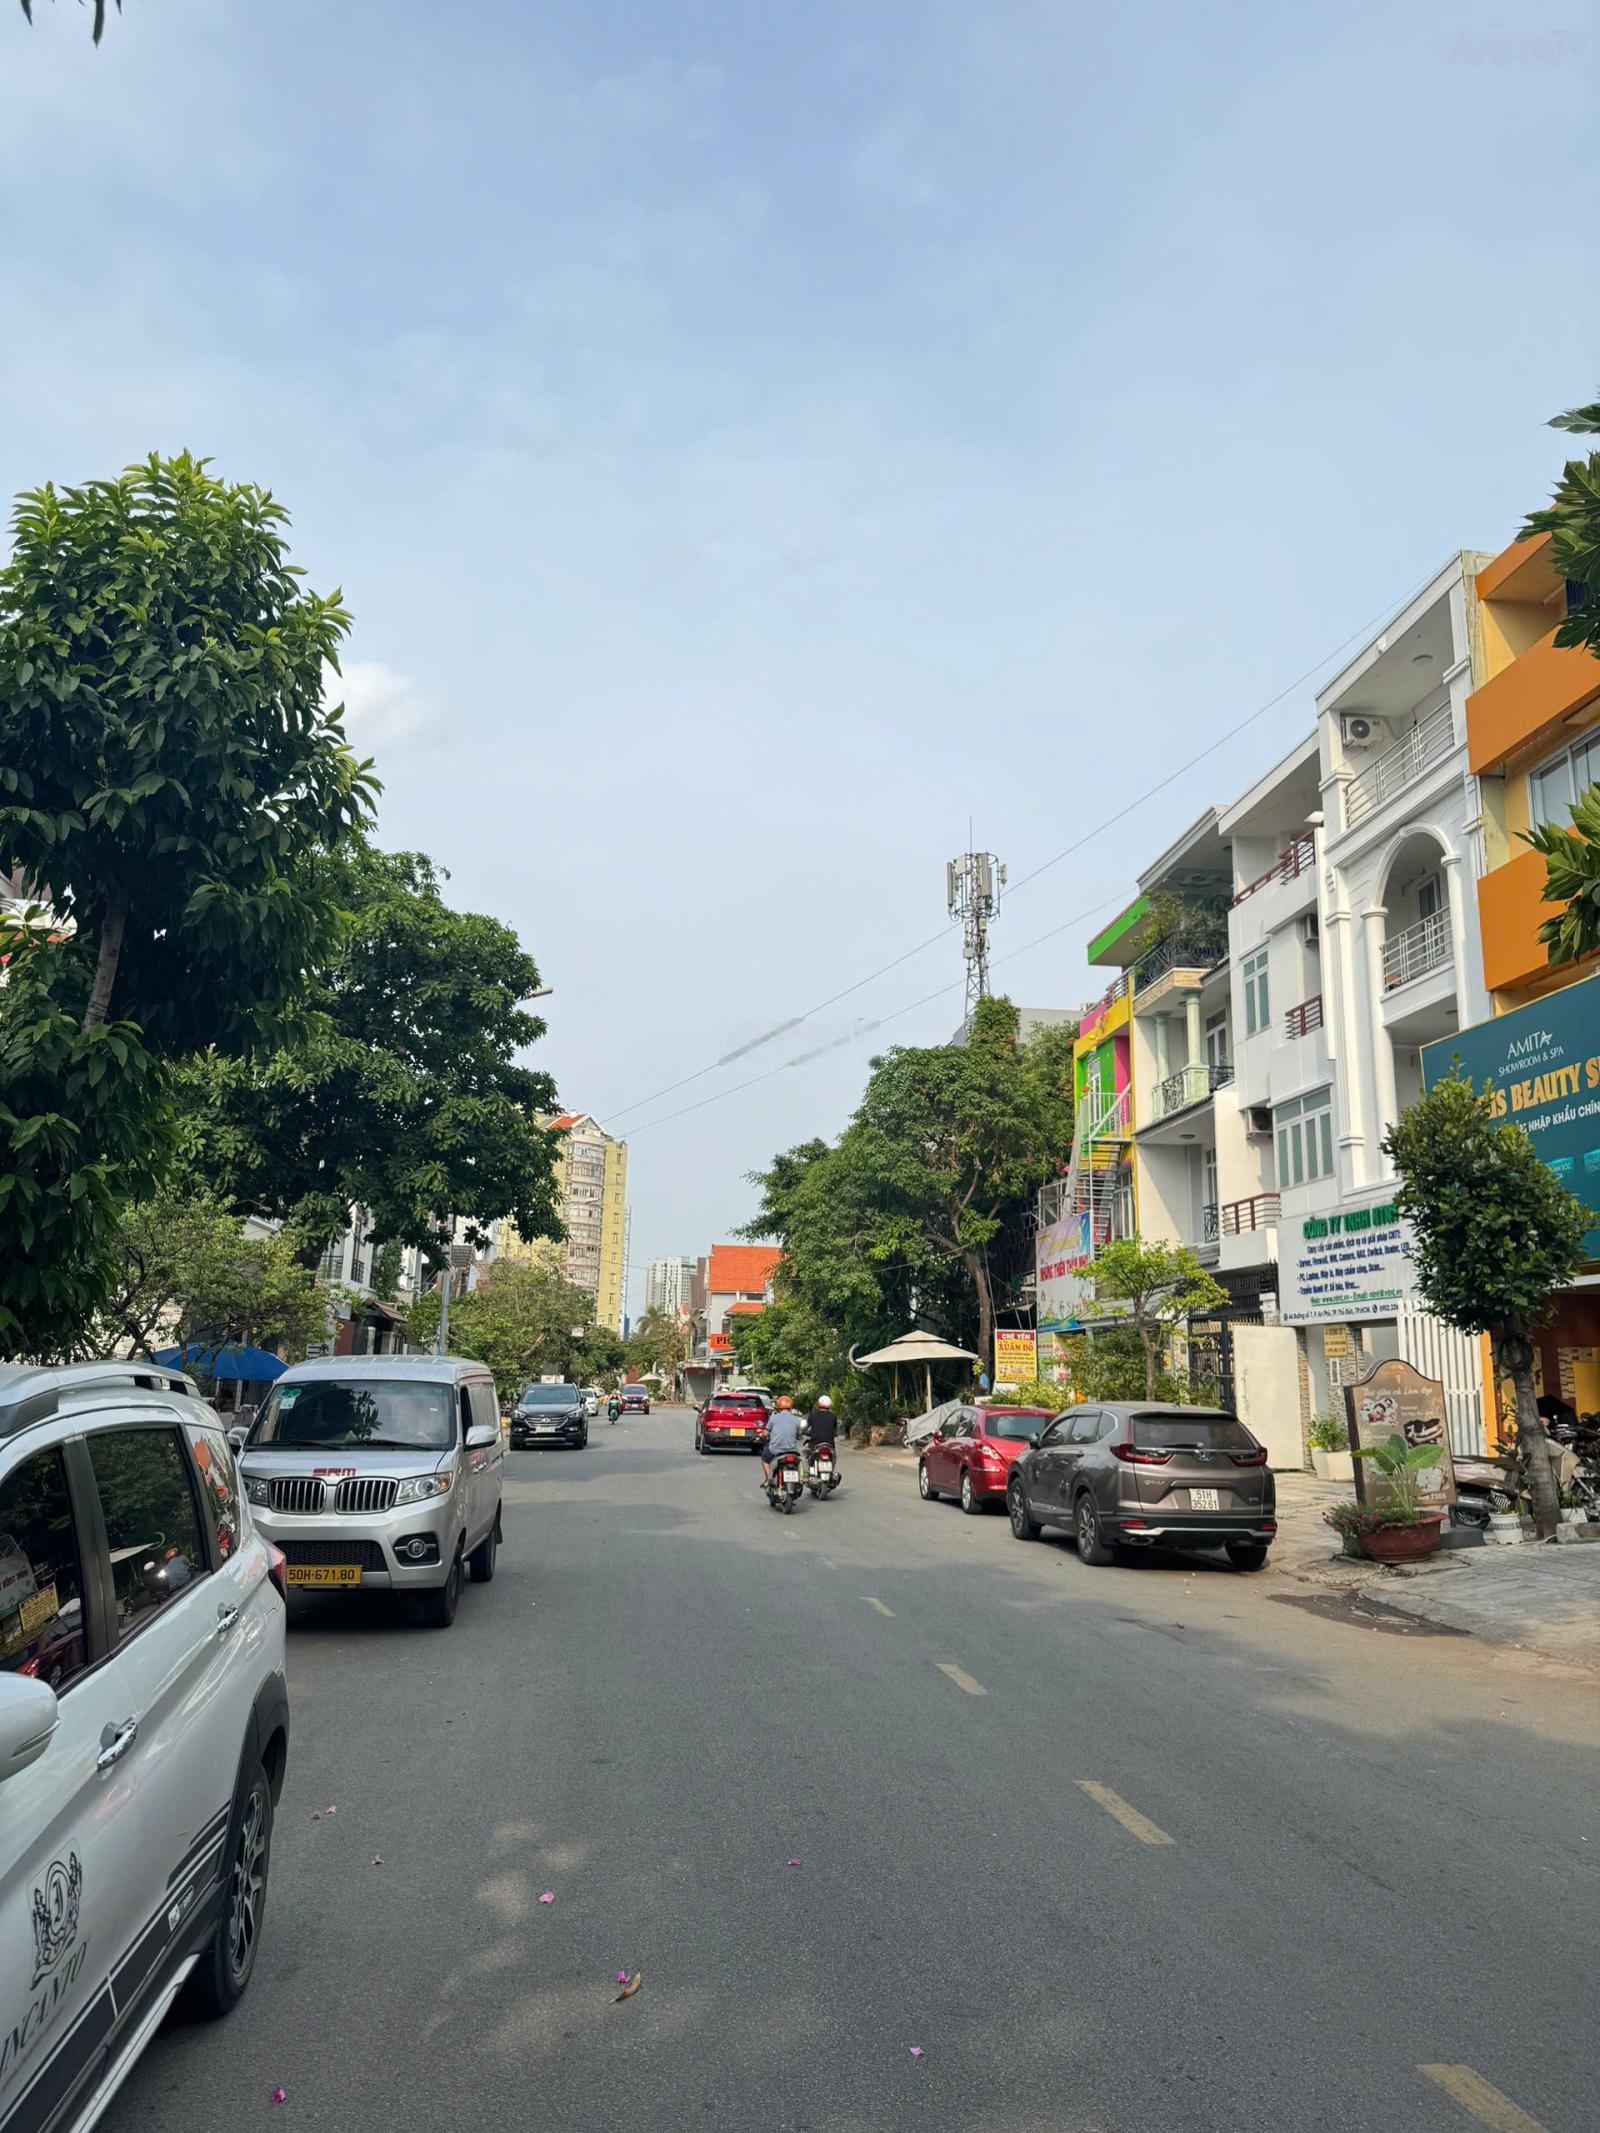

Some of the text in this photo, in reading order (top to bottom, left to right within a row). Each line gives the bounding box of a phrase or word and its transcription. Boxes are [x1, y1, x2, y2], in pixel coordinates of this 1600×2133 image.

[1507, 1030, 1552, 1059] AMITA
[1498, 1046, 1565, 1077] SHOWROOM & SPA
[1510, 1062, 1581, 1112] BEAUTY
[1585, 1056, 1600, 1088] S
[1528, 1114, 1551, 1132] NHẬP
[1552, 1104, 1576, 1125] KHẨU
[1328, 1214, 1341, 1234] TY
[1196, 1490, 1212, 1500] 51H
